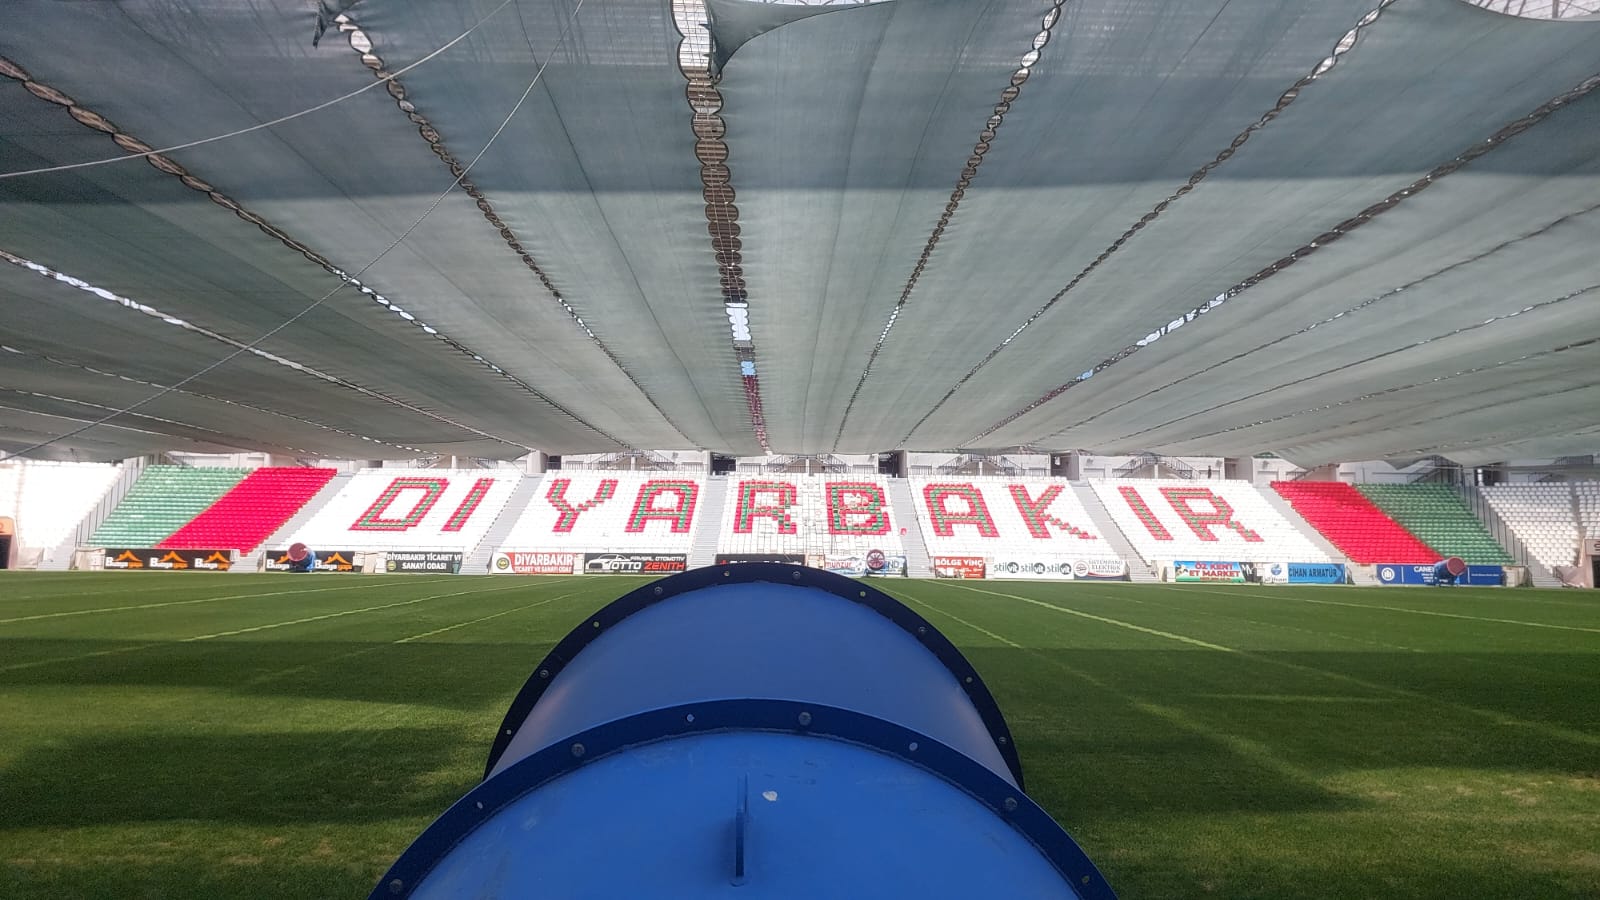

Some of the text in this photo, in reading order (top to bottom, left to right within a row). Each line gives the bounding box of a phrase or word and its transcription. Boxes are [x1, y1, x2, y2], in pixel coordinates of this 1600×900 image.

[514, 553, 574, 566] DİYARBAKIR
[402, 561, 426, 570] SANAYİ
[611, 561, 685, 570] OTTO ZENITH
